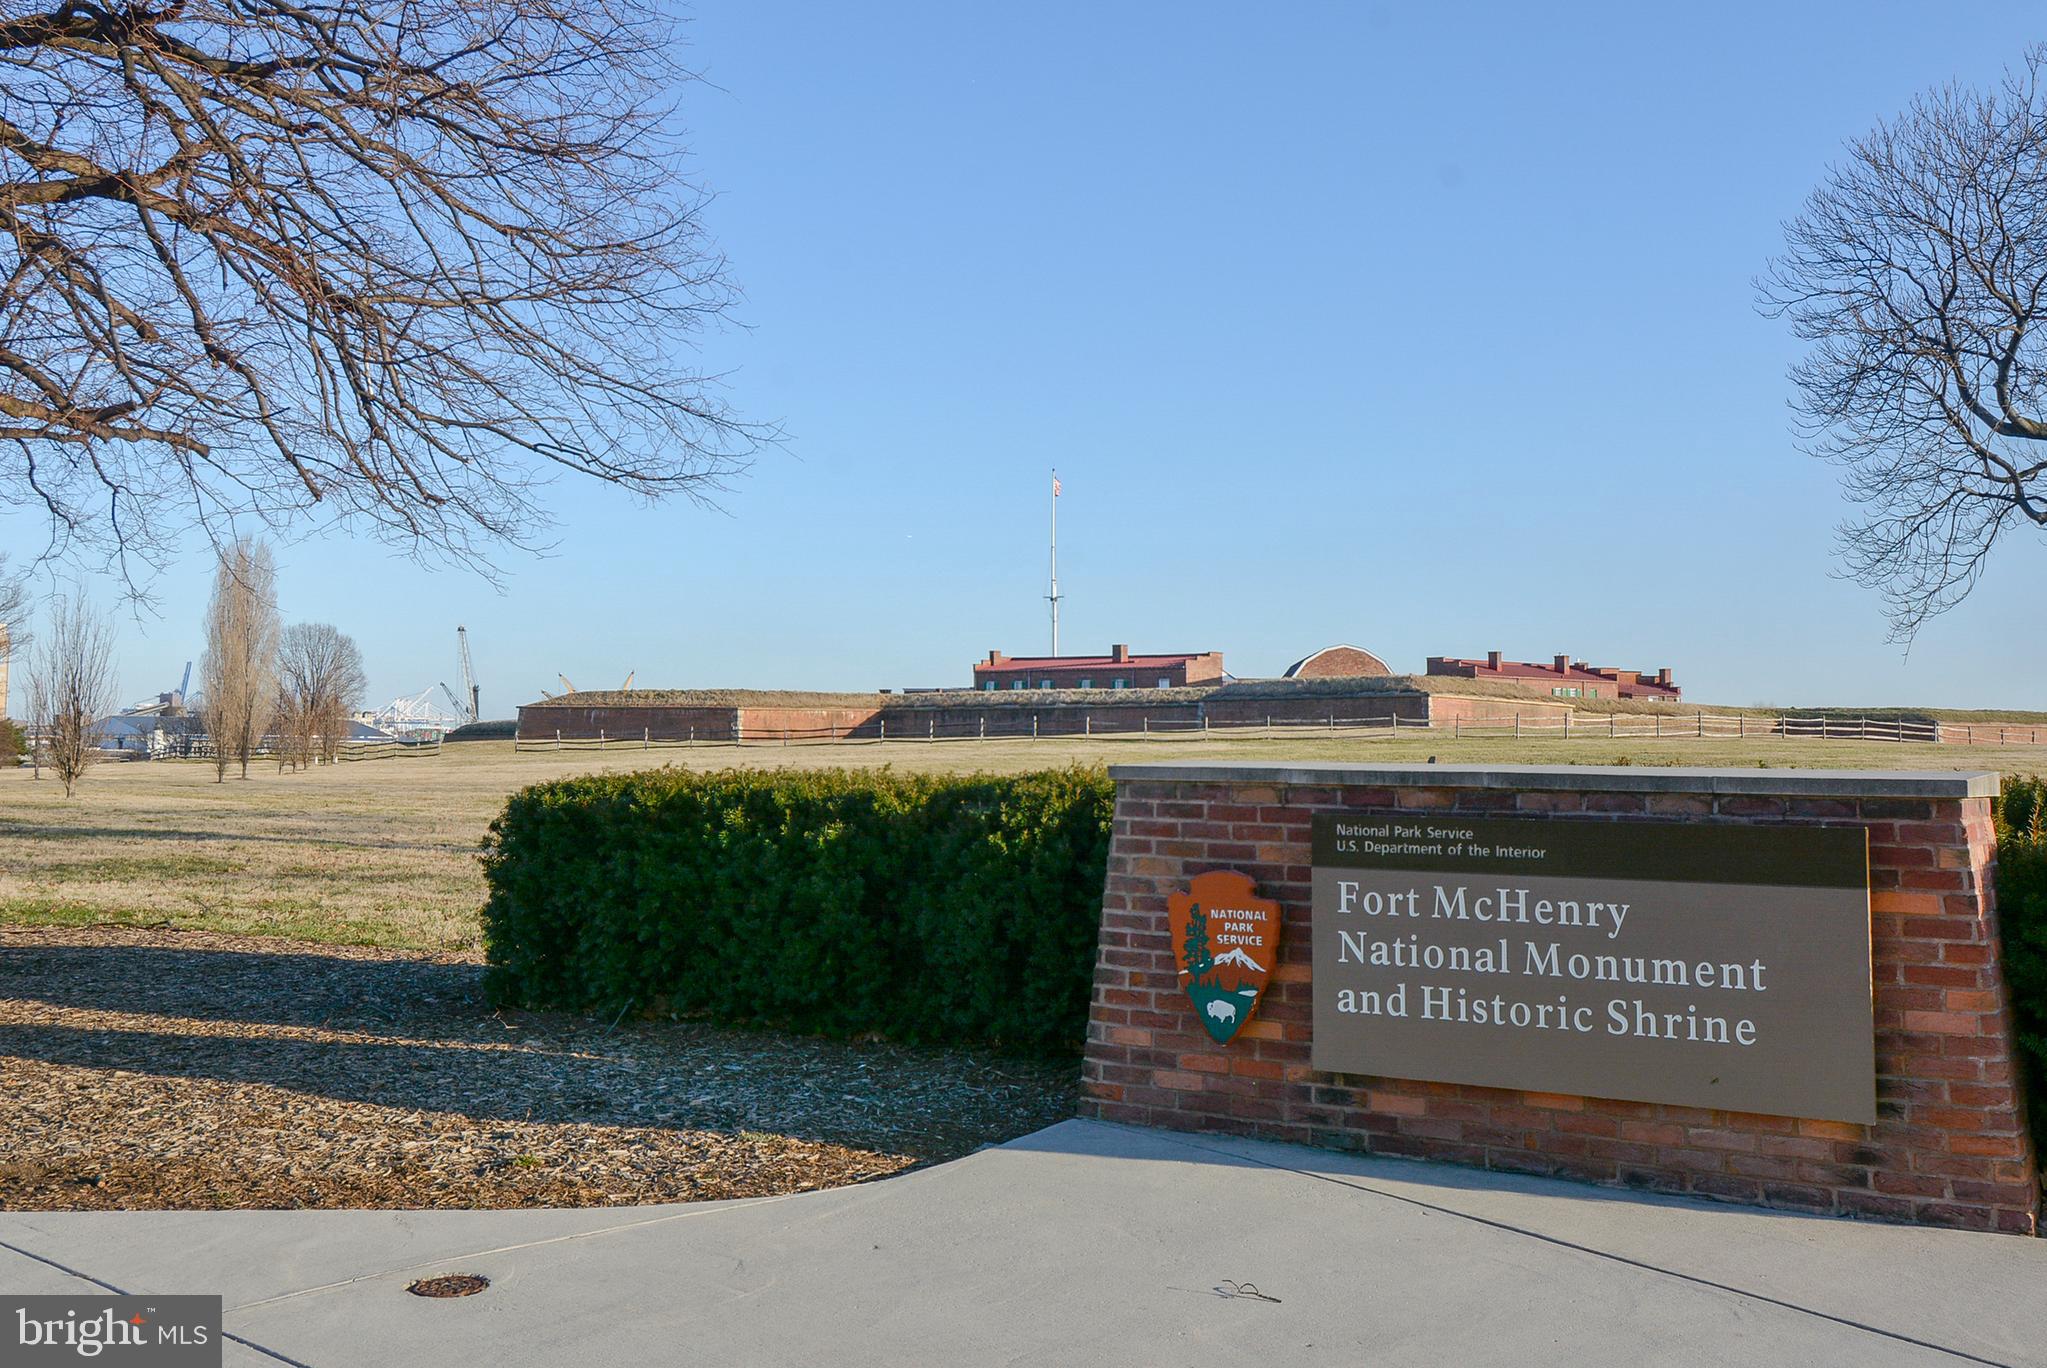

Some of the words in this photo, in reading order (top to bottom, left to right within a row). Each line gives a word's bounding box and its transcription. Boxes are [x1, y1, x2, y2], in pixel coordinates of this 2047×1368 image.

[1336, 823, 1390, 838] National
[1394, 825, 1422, 840] Park
[1427, 826, 1474, 840] Service
[1336, 839, 1360, 853] U.S.
[1364, 840, 1444, 856] Department
[1447, 843, 1464, 856] of
[1467, 844, 1490, 857] the
[1495, 845, 1546, 859] Interior
[1210, 909, 1268, 921] NATIONAL
[1337, 881, 1420, 918] Fort
[1432, 885, 1630, 938] McHenry
[1224, 922, 1254, 933] PARK
[1216, 934, 1263, 946] SERVICE
[1337, 930, 1510, 974] National
[1523, 941, 1767, 991] Monument
[1336, 983, 1408, 1018] and
[1420, 986, 1594, 1033] Historic
[1607, 999, 1757, 1046] Shrine
